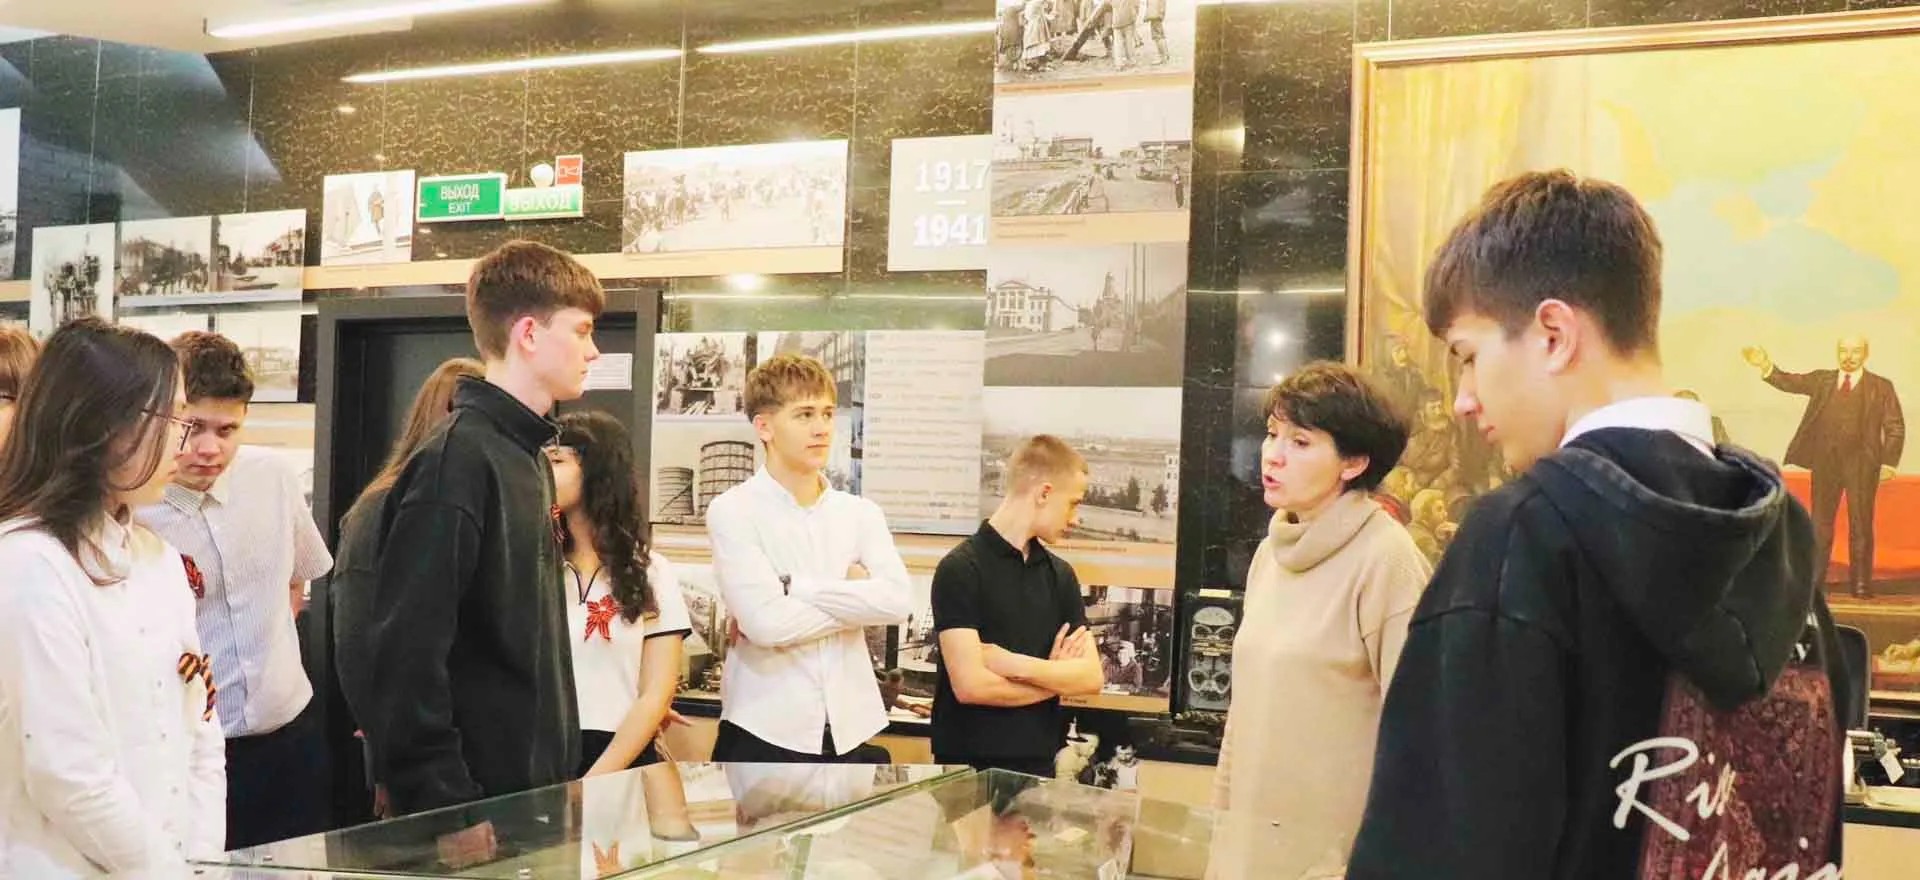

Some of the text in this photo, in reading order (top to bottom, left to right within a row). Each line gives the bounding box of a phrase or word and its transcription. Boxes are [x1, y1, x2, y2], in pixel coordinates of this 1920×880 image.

[914, 158, 992, 194] 1917
[440, 183, 480, 200] ВЫХОД
[511, 190, 571, 212] ВЫХОД
[448, 202, 471, 214] EXIT
[913, 211, 989, 247] 1941
